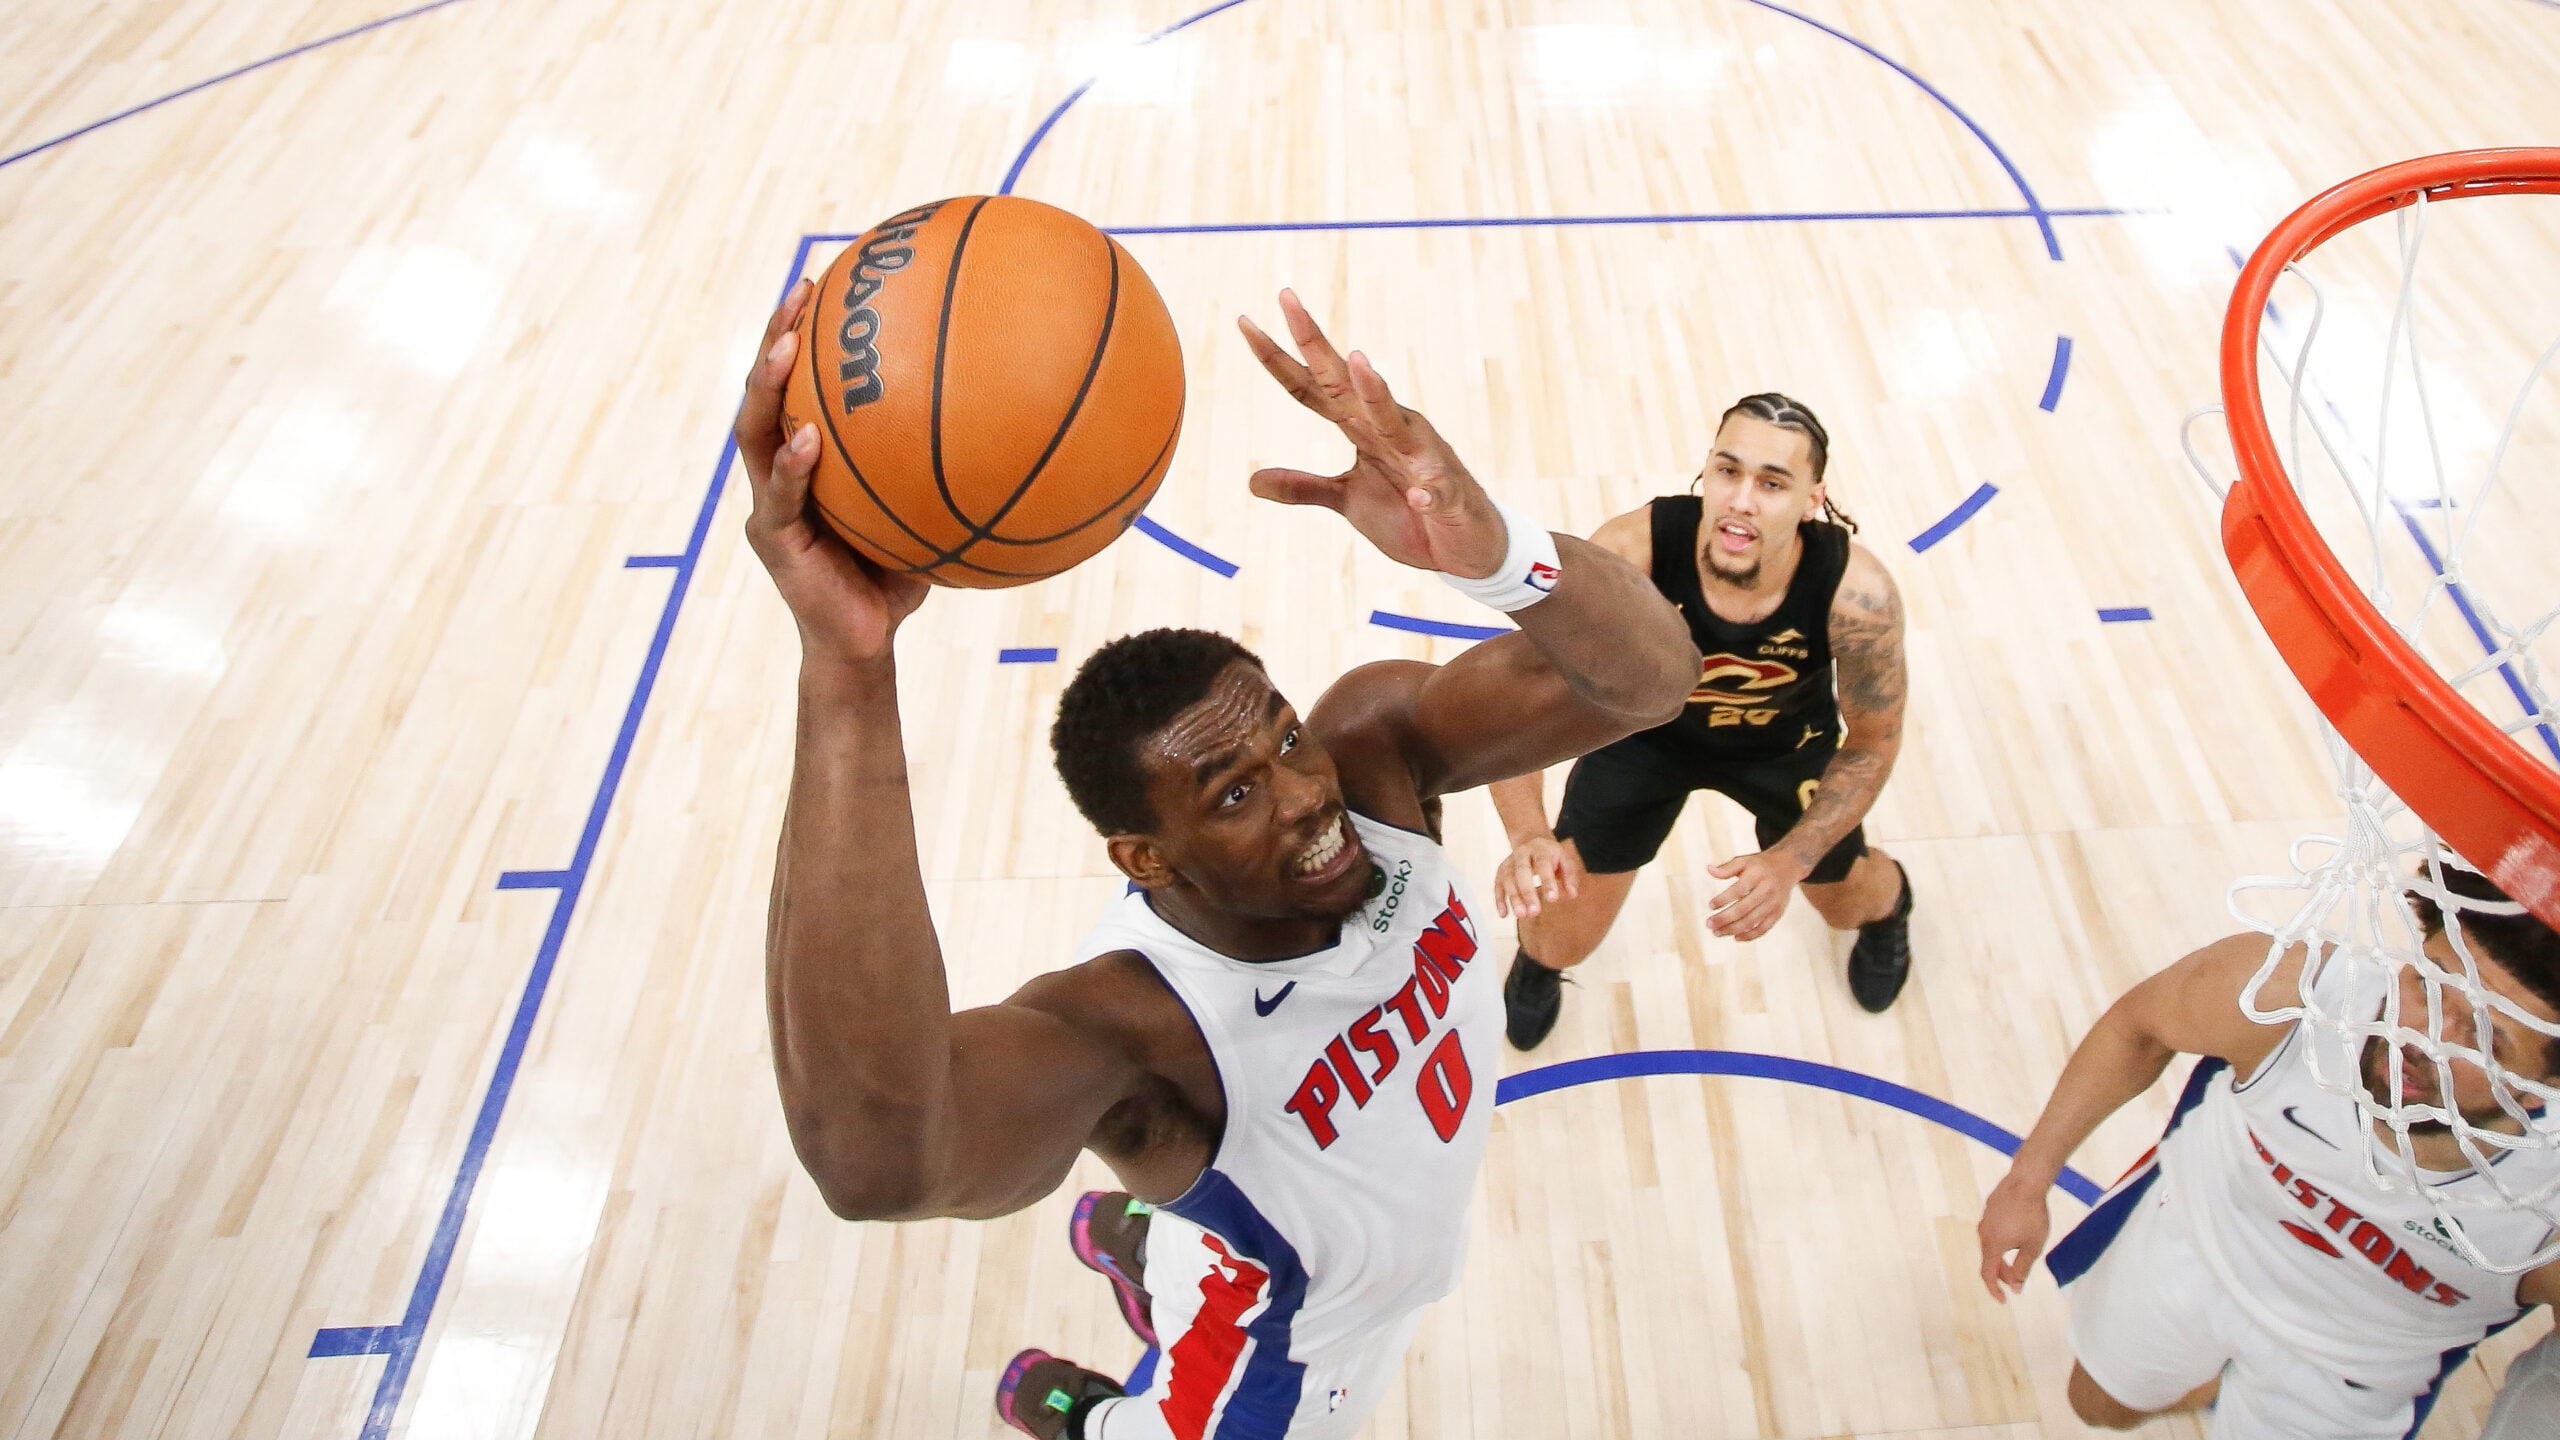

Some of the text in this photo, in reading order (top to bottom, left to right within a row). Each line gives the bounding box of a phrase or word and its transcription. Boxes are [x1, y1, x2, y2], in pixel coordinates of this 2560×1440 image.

[1757, 645, 1809, 660] CLIFFS
[1708, 705, 1780, 728] 20
[1416, 1028, 1473, 1144] 0
[2403, 1220, 2473, 1267] Stoc
